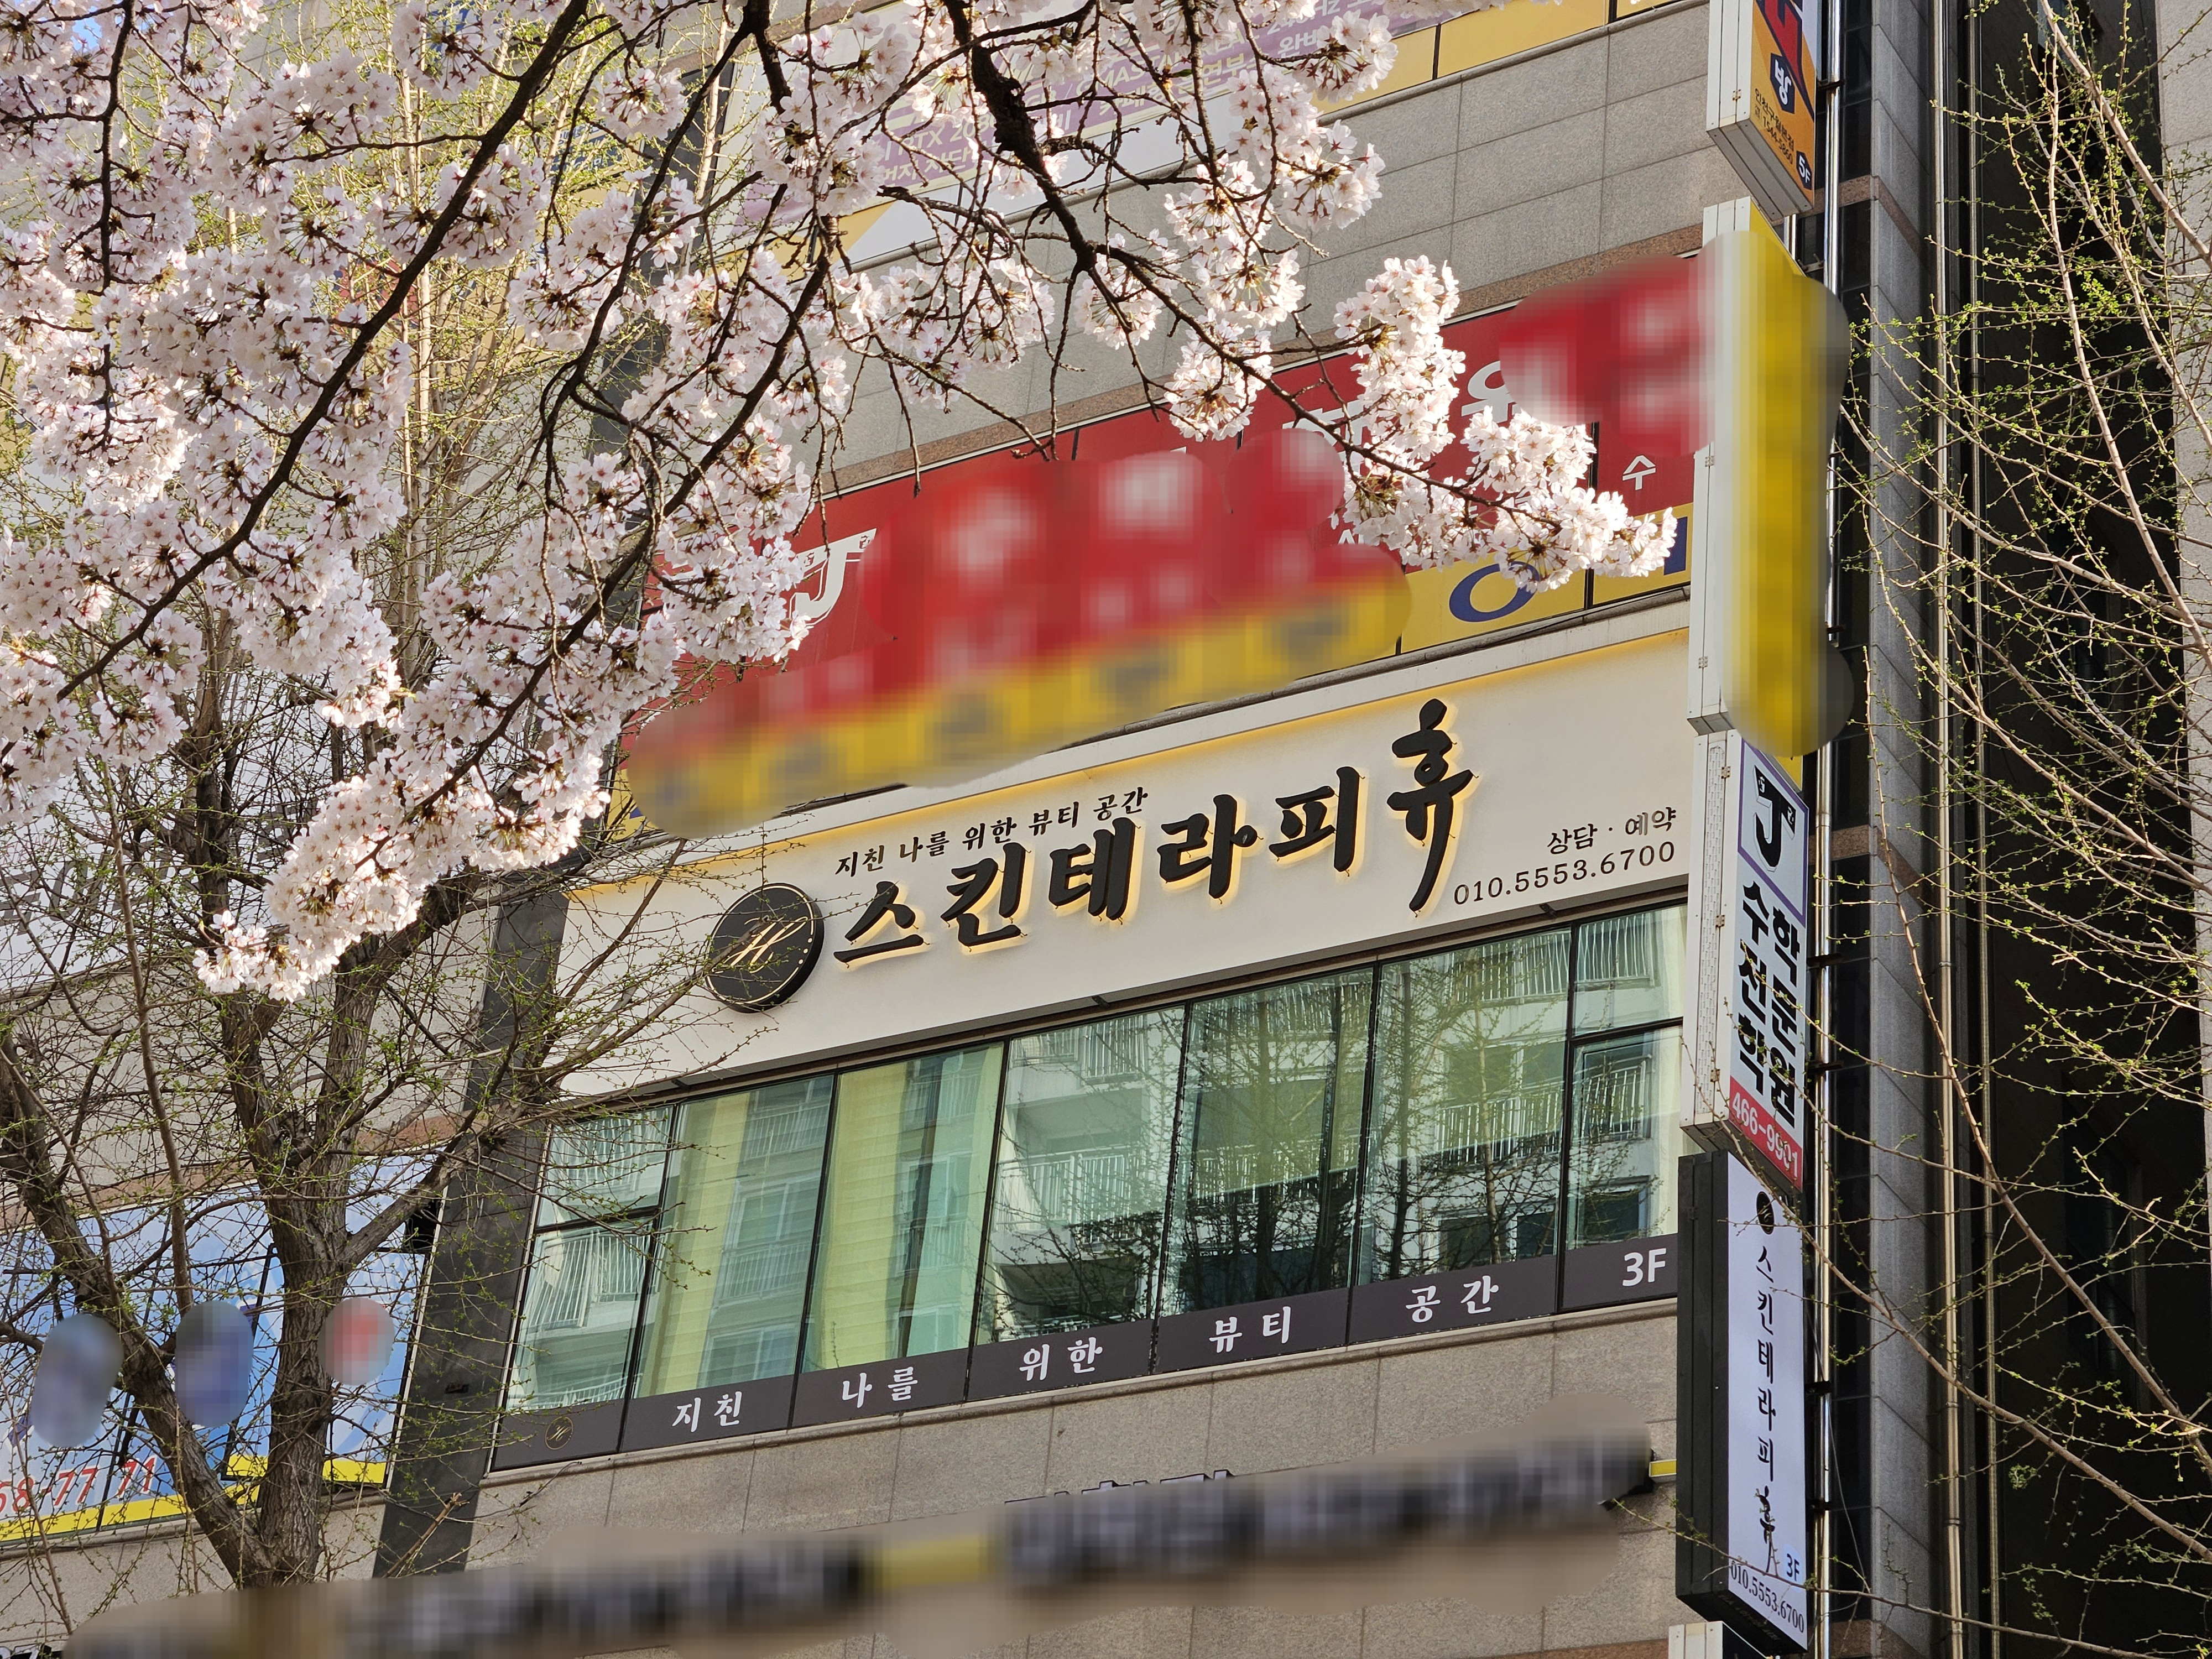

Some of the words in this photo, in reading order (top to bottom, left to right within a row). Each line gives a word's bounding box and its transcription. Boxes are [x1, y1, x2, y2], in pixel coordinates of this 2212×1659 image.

[1798, 155, 1811, 184] 5F
[836, 845, 886, 877] 지친
[900, 831, 950, 863] 나를
[962, 817, 1017, 851] 위한
[1029, 801, 1079, 836] 뷰티
[1093, 786, 1149, 821] 공간
[1547, 823, 1597, 855] 상담
[1625, 806, 1677, 838] 예약
[1454, 841, 1675, 906] 010.5553.6700
[1733, 1092, 1798, 1177] 466-9901
[1622, 1248, 1666, 1287] 3F
[672, 1391, 742, 1432] 지친
[842, 1366, 918, 1408] 나를
[1019, 1337, 1103, 1381] 위한
[1209, 1306, 1291, 1353] 뷰티
[1405, 1275, 1499, 1323] 공간
[1731, 1560, 1804, 1633] 010.5553.6700
[1787, 1553, 1799, 1582] 3F
